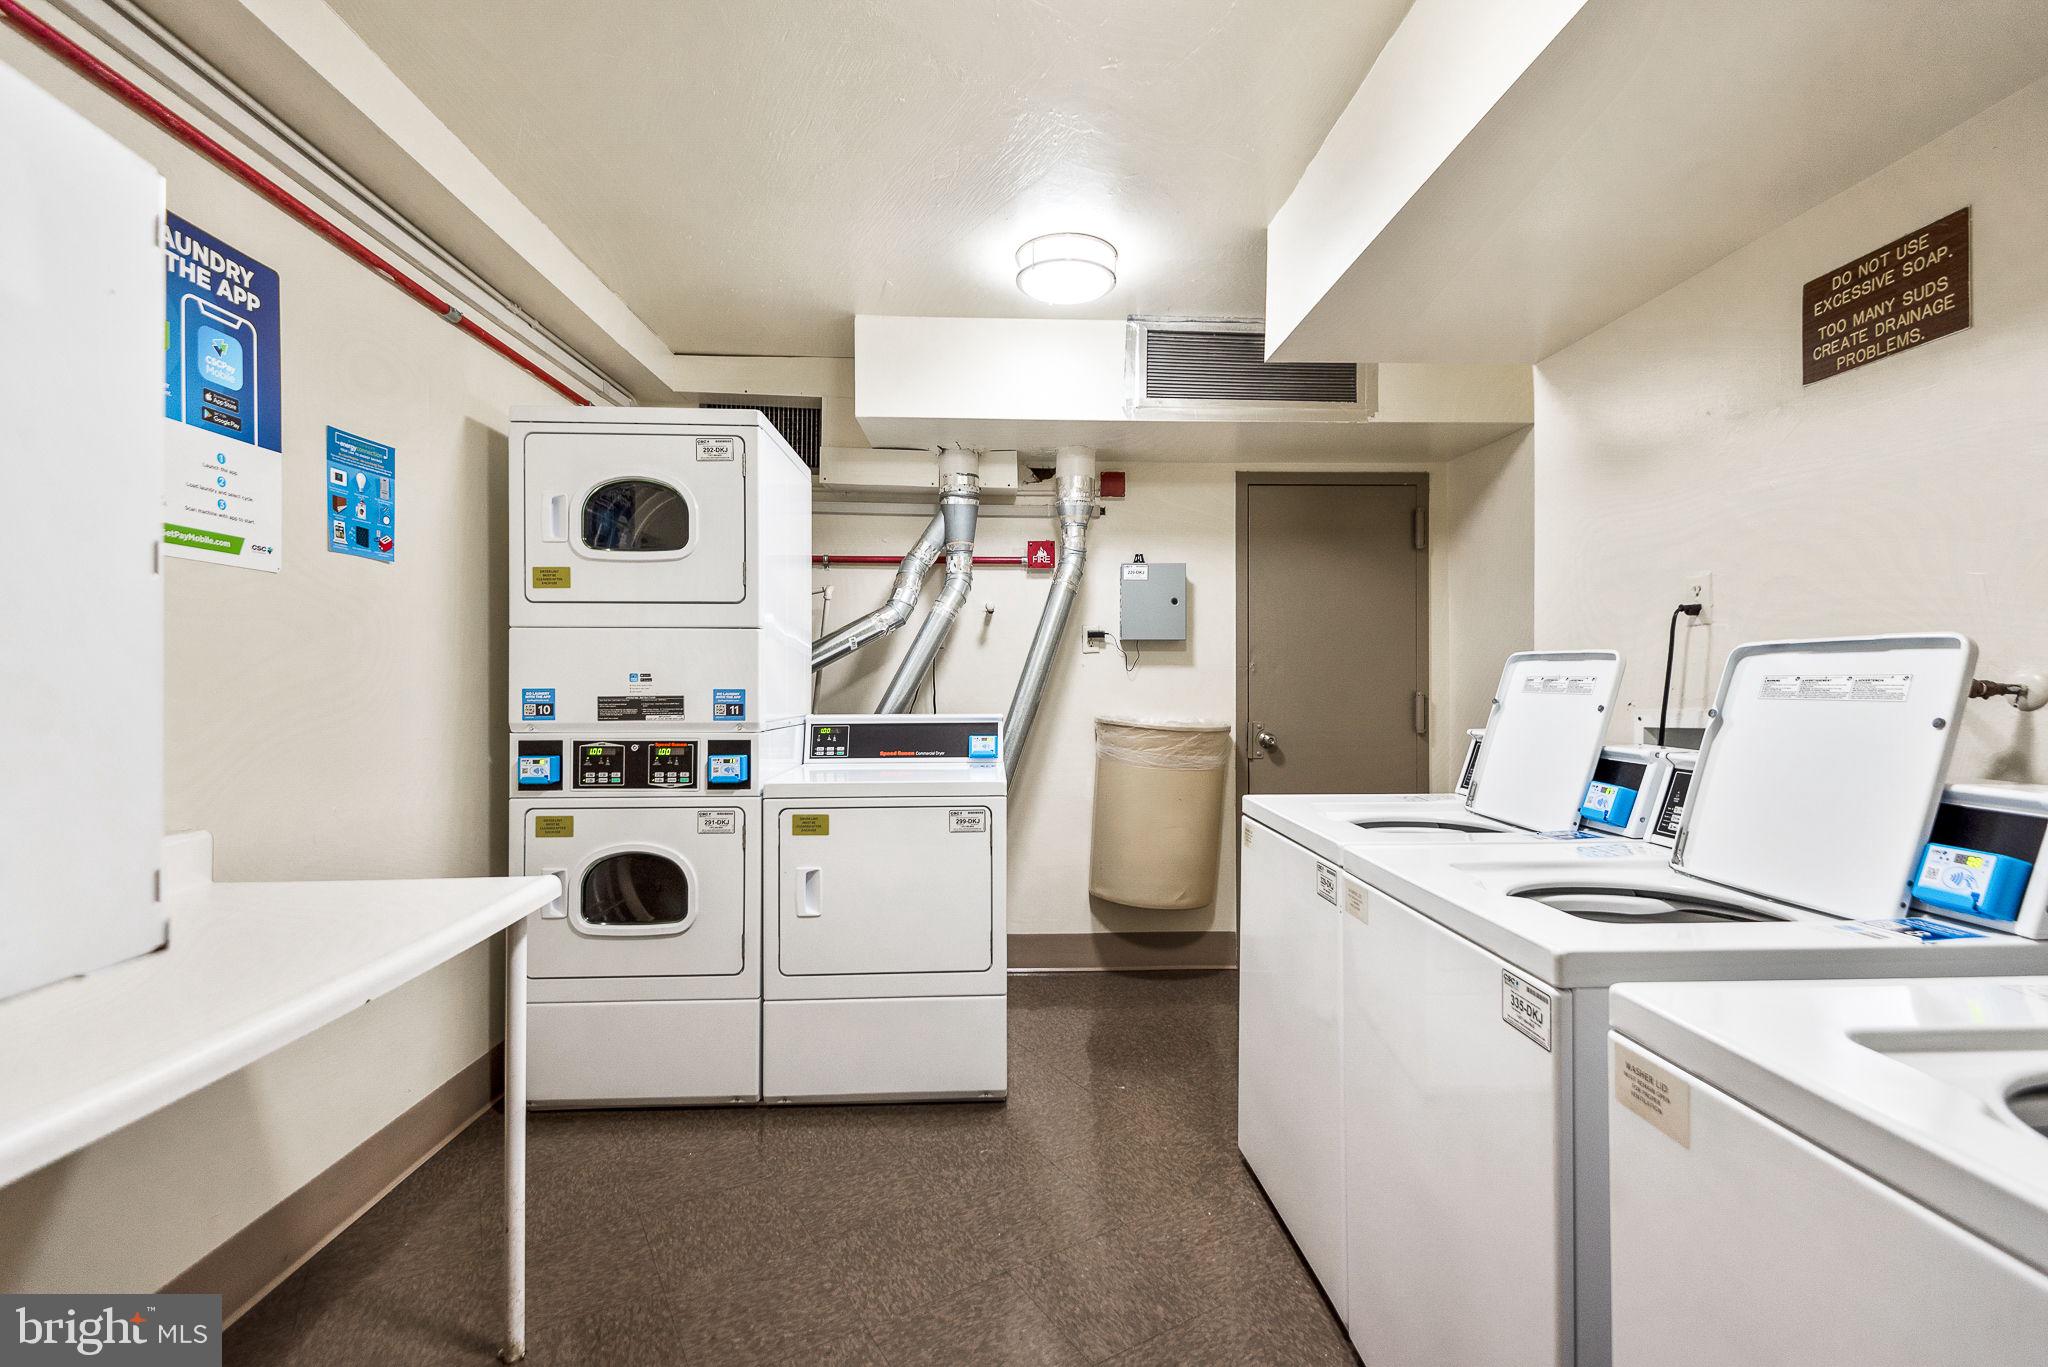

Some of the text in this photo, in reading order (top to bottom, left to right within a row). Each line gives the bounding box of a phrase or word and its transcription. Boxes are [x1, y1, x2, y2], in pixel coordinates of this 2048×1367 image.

[1832, 233, 1930, 291] DO NOT USE
[164, 249, 261, 312] THE APP
[1814, 246, 1953, 317] EXCESSIVE SOAP.
[1818, 276, 1949, 341] TOO MANY SUDS
[1813, 293, 1956, 361] CREATE DRAINAGE
[1836, 328, 1925, 371] PROBLEMS.
[163, 528, 231, 548] etPayMobile.com
[251, 544, 267, 552] CSC
[1032, 555, 1051, 563] FIRE
[537, 705, 551, 715] 10
[729, 705, 740, 715] 11
[1510, 994, 1544, 1024] 335-DKJ
[1625, 1061, 1669, 1093] WASHER LID
